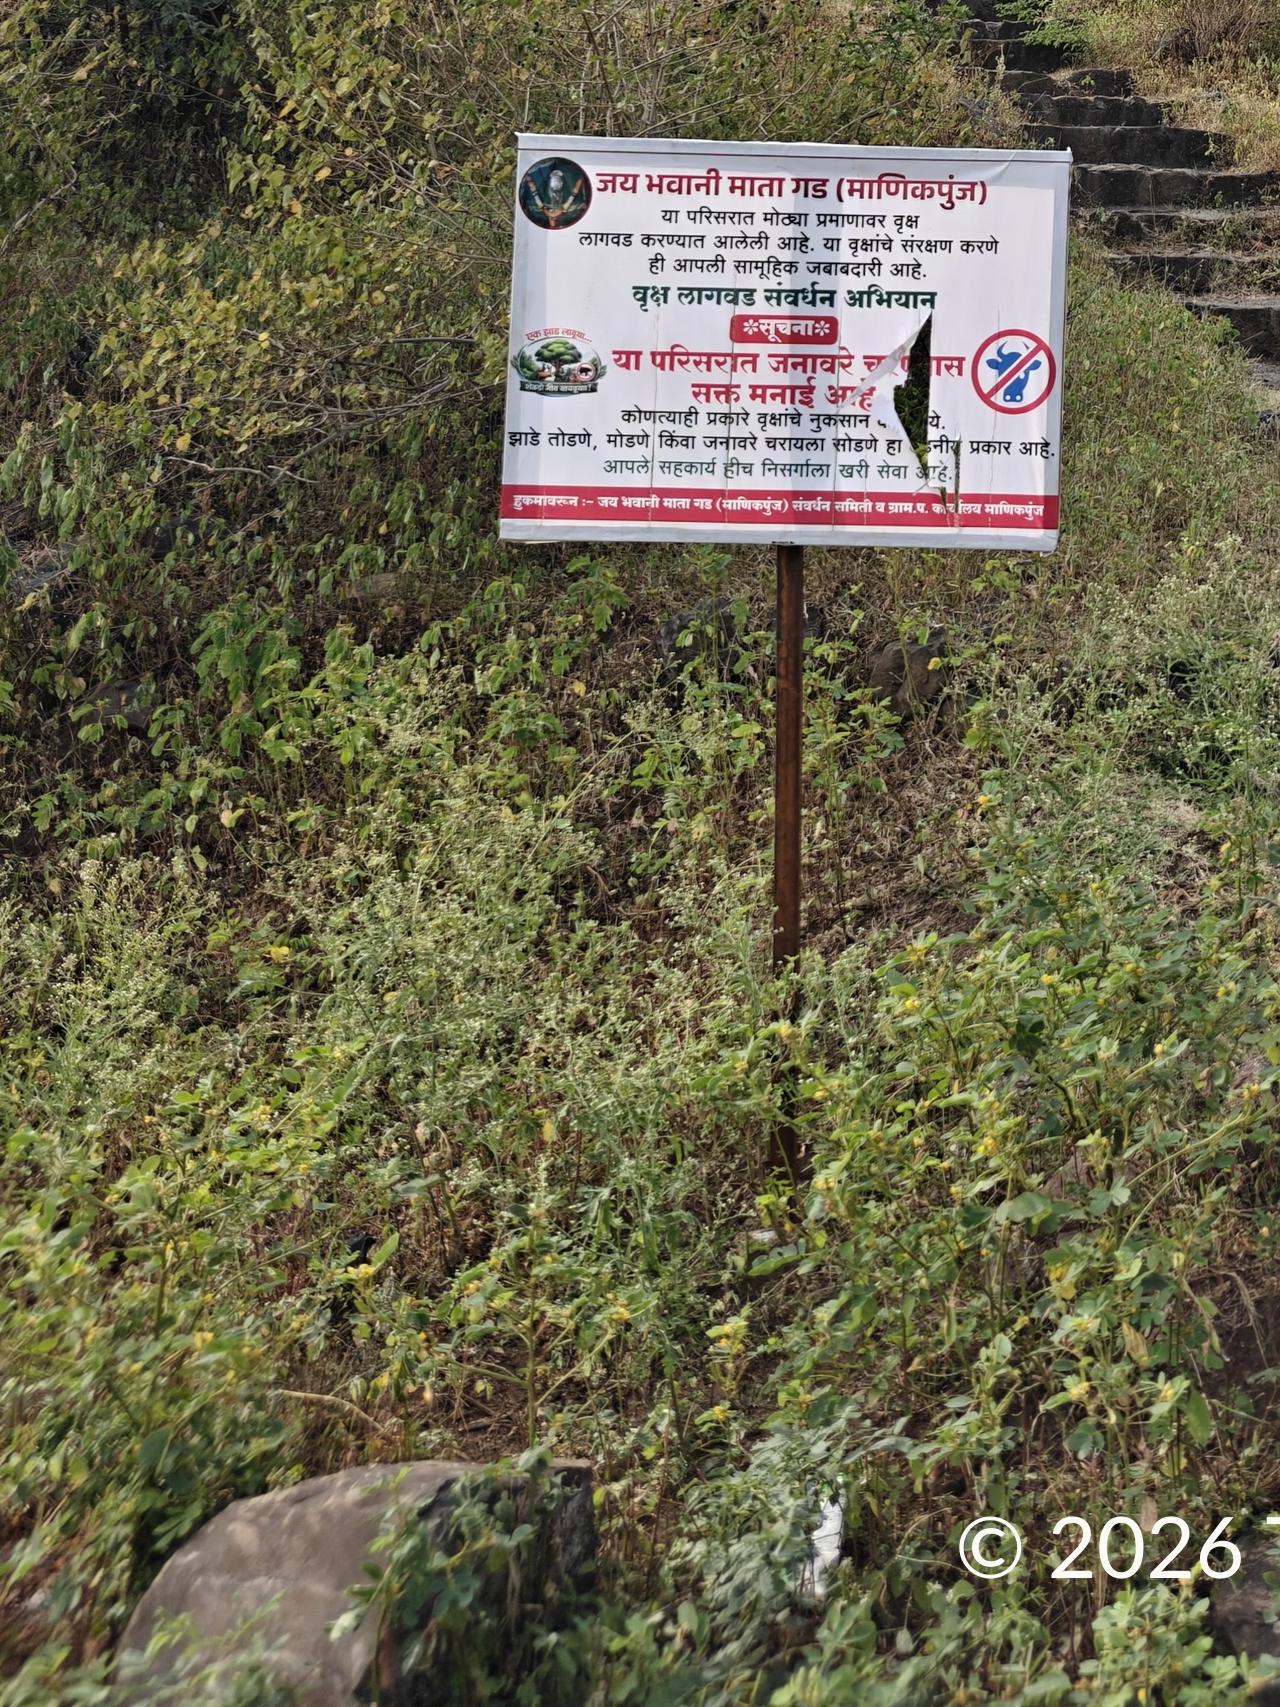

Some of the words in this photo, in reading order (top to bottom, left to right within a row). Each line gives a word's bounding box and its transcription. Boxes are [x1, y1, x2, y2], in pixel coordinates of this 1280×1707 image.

[596, 173, 640, 193] जय
[646, 168, 722, 195] भवानी
[728, 177, 785, 197] माता
[791, 178, 829, 198] गड
[837, 173, 986, 210] (माणिकपुंज)
[661, 210, 680, 223] या
[687, 207, 755, 225] परिसरात
[763, 207, 809, 227] मोठ्या
[816, 214, 886, 228] प्रमाणावर
[894, 215, 920, 234] वृक्ष
[579, 233, 634, 247] लागवड
[641, 234, 706, 248] करण्यात
[714, 231, 770, 249] आलेली
[778, 232, 814, 254] आहे.
[823, 238, 841, 251] या
[848, 234, 894, 257] वृक्षांचे
[901, 235, 953, 253] संरक्षण
[960, 236, 999, 254] करणे
[649, 253, 666, 274] ही
[674, 254, 726, 273] आपली
[733, 256, 799, 280] सामूहिक
[806, 257, 882, 277] जबाबदारी
[890, 258, 926, 280] आहे.
[632, 286, 670, 312] वृक्ष
[678, 287, 757, 306] लागवड
[764, 281, 836, 308] संवर्धन
[845, 284, 937, 309] अभियान
[759, 319, 814, 342] सूचना
[612, 350, 642, 370] या
[650, 344, 759, 374] परिसरात
[768, 346, 854, 374] जनावरे
[691, 383, 741, 405] सक्त
[749, 378, 815, 408] मनाई
[621, 406, 699, 428] कोणत्याही
[706, 408, 750, 430] प्रकारे
[757, 408, 802, 431] वृक्षांचे
[810, 414, 870, 433] नुकसान
[508, 428, 541, 447] झाडे
[548, 429, 596, 450] तोडणे,
[606, 430, 650, 448] मोडणे
[658, 430, 696, 449] किंवा
[703, 431, 758, 451] जनावरे
[765, 438, 826, 451] चरायला
[832, 434, 879, 452] सोडणे
[886, 440, 903, 455] हा
[969, 441, 1012, 455] प्रकार
[1019, 438, 1055, 459] आहे.
[604, 455, 650, 473] आपले
[659, 457, 716, 477] सहकार्य
[723, 457, 754, 479] हीच
[761, 458, 831, 477] निसर्गाला
[839, 459, 868, 478] खरी
[877, 460, 908, 479] सेवा
[598, 497, 618, 507] जय
[622, 494, 660, 508] भवानी
[663, 498, 691, 508] माता
[694, 499, 712, 509] गड
[716, 496, 788, 515] (माणिकपुंज)
[792, 497, 831, 511] संवर्धन
[835, 498, 872, 512] समिती
[875, 502, 885, 512] व
[985, 501, 1044, 520] माणिकपुंज
